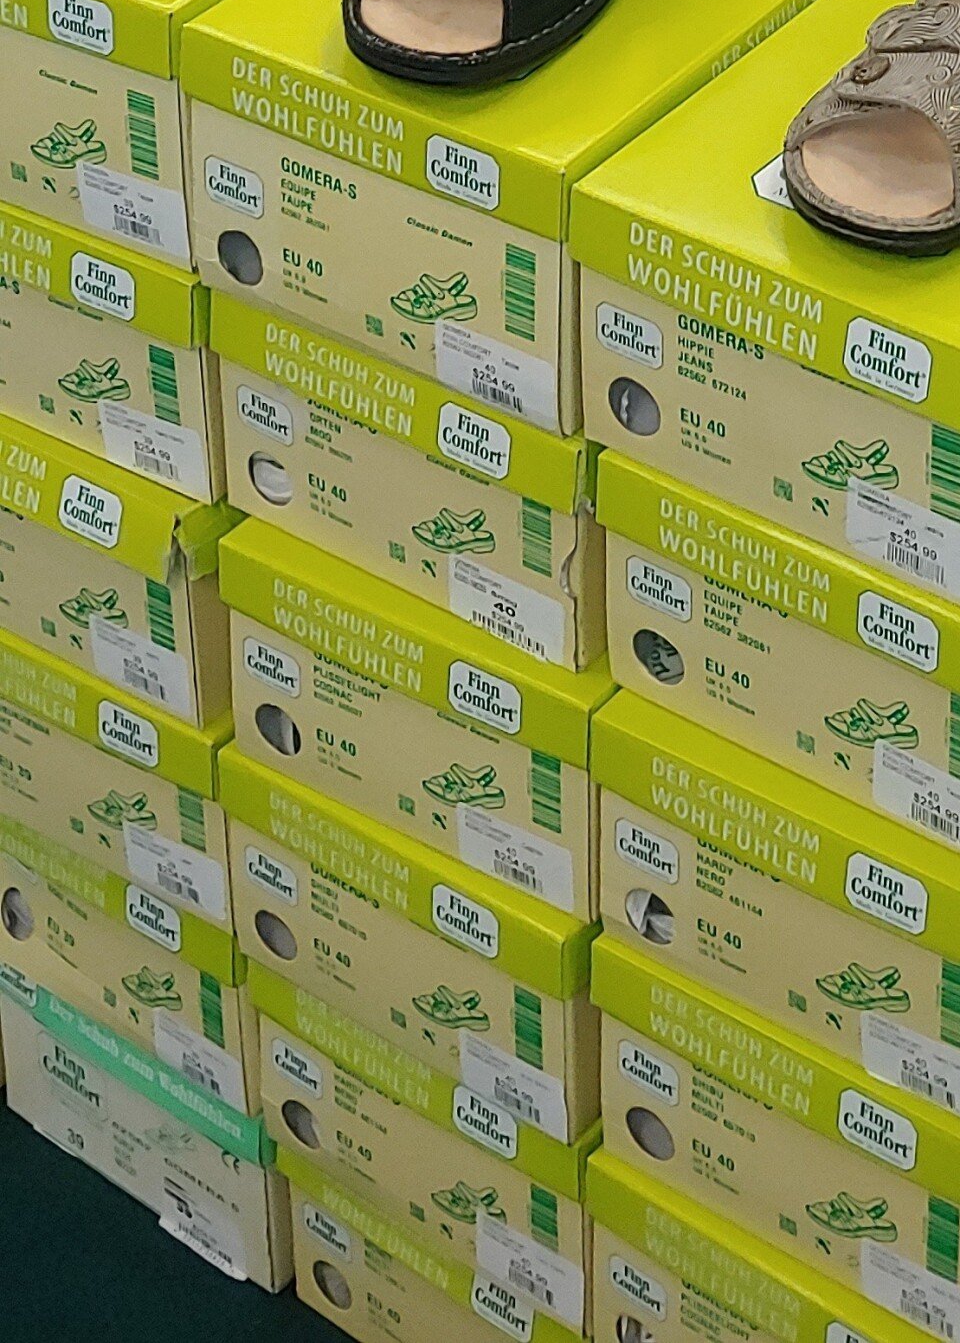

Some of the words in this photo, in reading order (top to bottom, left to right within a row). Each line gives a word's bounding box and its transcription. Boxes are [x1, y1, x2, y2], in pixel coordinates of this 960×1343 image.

[232, 56, 272, 90] DER
[279, 72, 350, 120] SCHUH
[357, 102, 404, 141] ZUM
[232, 87, 403, 175] WOHLFÜHLEN
[281, 157, 357, 199] GOMERA-S
[281, 179, 316, 200] EQUIPE
[281, 192, 313, 213] TAUPE
[283, 248, 301, 267] EU
[307, 259, 323, 277] 40
[629, 222, 675, 260] DER
[682, 238, 761, 294] SCHUH
[770, 278, 824, 323] ZUM
[628, 254, 820, 362] WOHLFÜHLEN
[678, 314, 764, 360] GOMERA-S
[678, 336, 715, 359] HIPPIE
[868, 329, 907, 362] Finn
[266, 323, 300, 358] DER
[307, 337, 368, 385] SCHUH
[377, 369, 417, 407] ZUM
[678, 351, 713, 373] JEANS
[850, 345, 925, 388] Comfort
[266, 351, 413, 438] WOHLFÜHLEN
[680, 408, 701, 428] EU
[707, 420, 726, 438] 40
[308, 473, 326, 492] EU
[331, 485, 347, 502] 40
[660, 497, 700, 533] DER
[706, 517, 778, 568] SCHUH
[784, 554, 832, 593] ZUM
[659, 525, 829, 624] WOHLFÜHLEN
[704, 590, 742, 615] EQUIPE
[704, 604, 739, 626] TAUPE
[879, 601, 916, 634] Finn
[863, 615, 934, 660] Comfort
[468, 671, 501, 700] Finn
[705, 657, 725, 677] EU
[732, 671, 749, 689] 40
[452, 684, 519, 724] Comfort
[696, 852, 733, 877] HARDY
[696, 865, 726, 887] NERO
[868, 862, 904, 896] Finn
[851, 876, 922, 923] Comfort
[697, 918, 717, 941] EU
[720, 928, 742, 950] 40
[859, 1101, 895, 1132] Finn
[844, 1113, 912, 1159] Comfort
